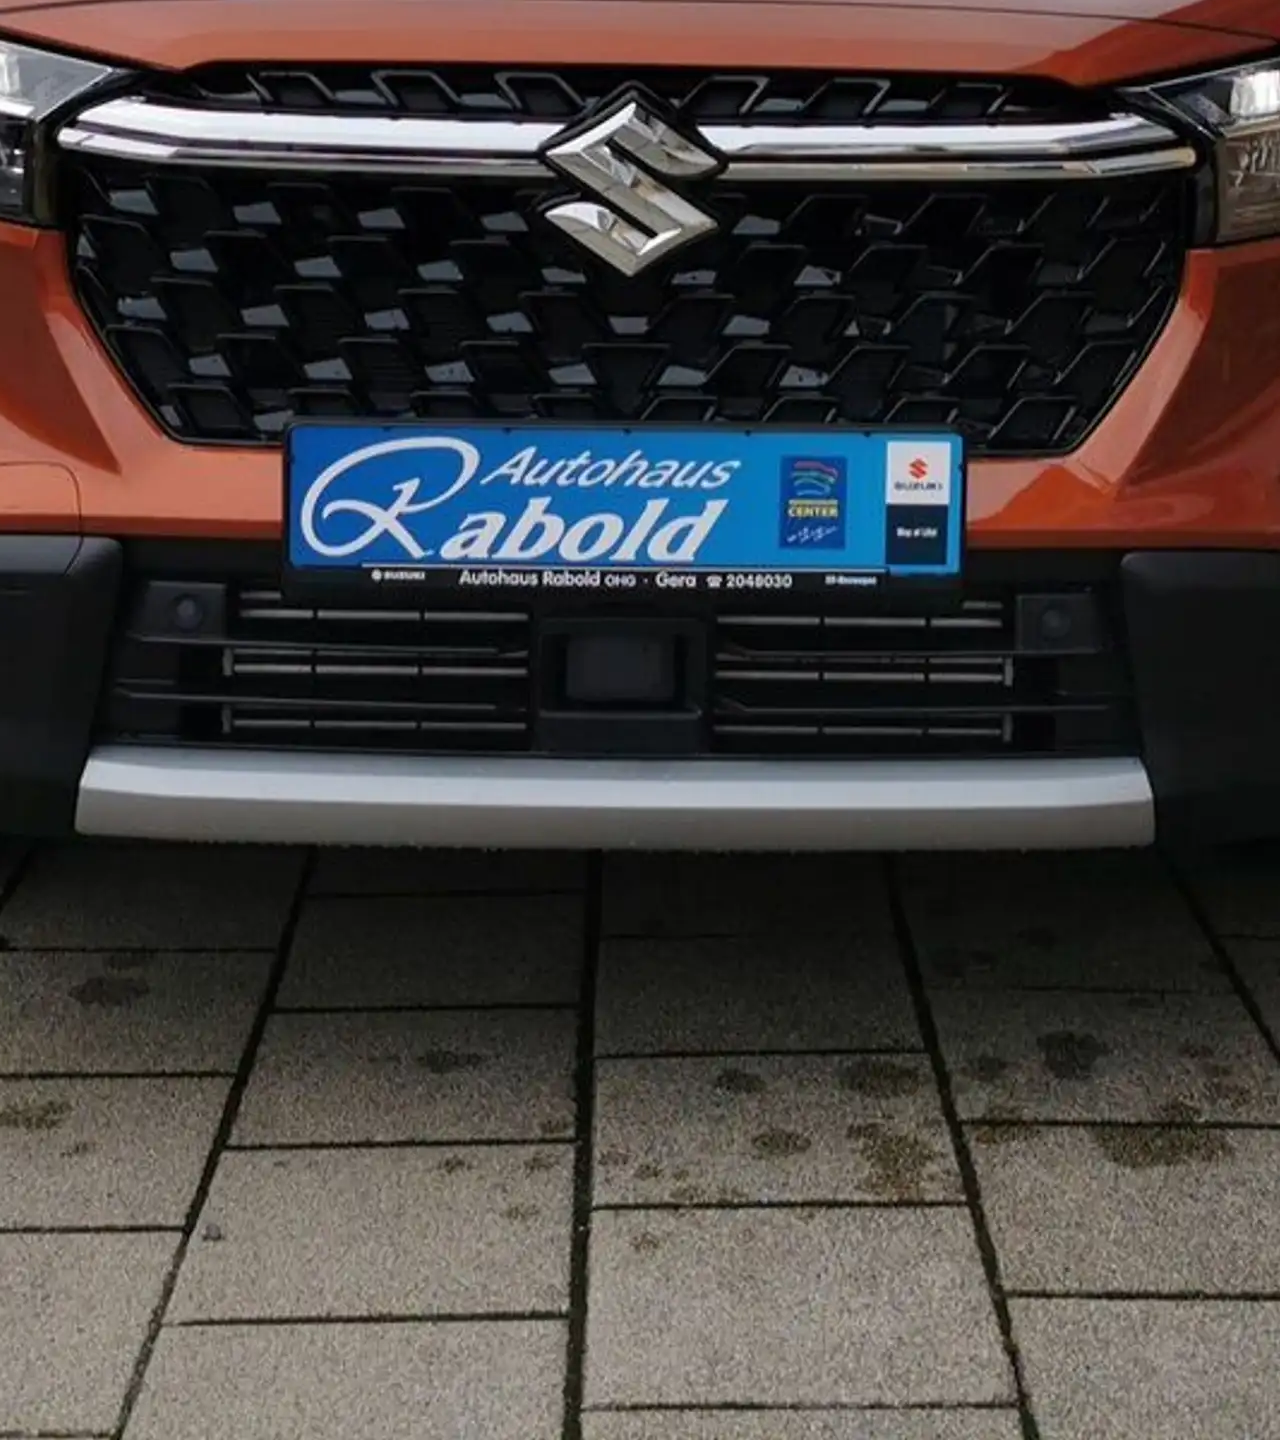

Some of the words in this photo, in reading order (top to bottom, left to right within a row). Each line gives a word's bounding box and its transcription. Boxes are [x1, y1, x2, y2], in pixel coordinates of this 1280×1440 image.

[479, 446, 741, 489] Autohaus
[300, 436, 729, 560] Rabold
[788, 506, 838, 517] CENTER
[458, 570, 539, 586] Autohaus
[542, 569, 601, 587] Rabold
[655, 571, 697, 588] Gera
